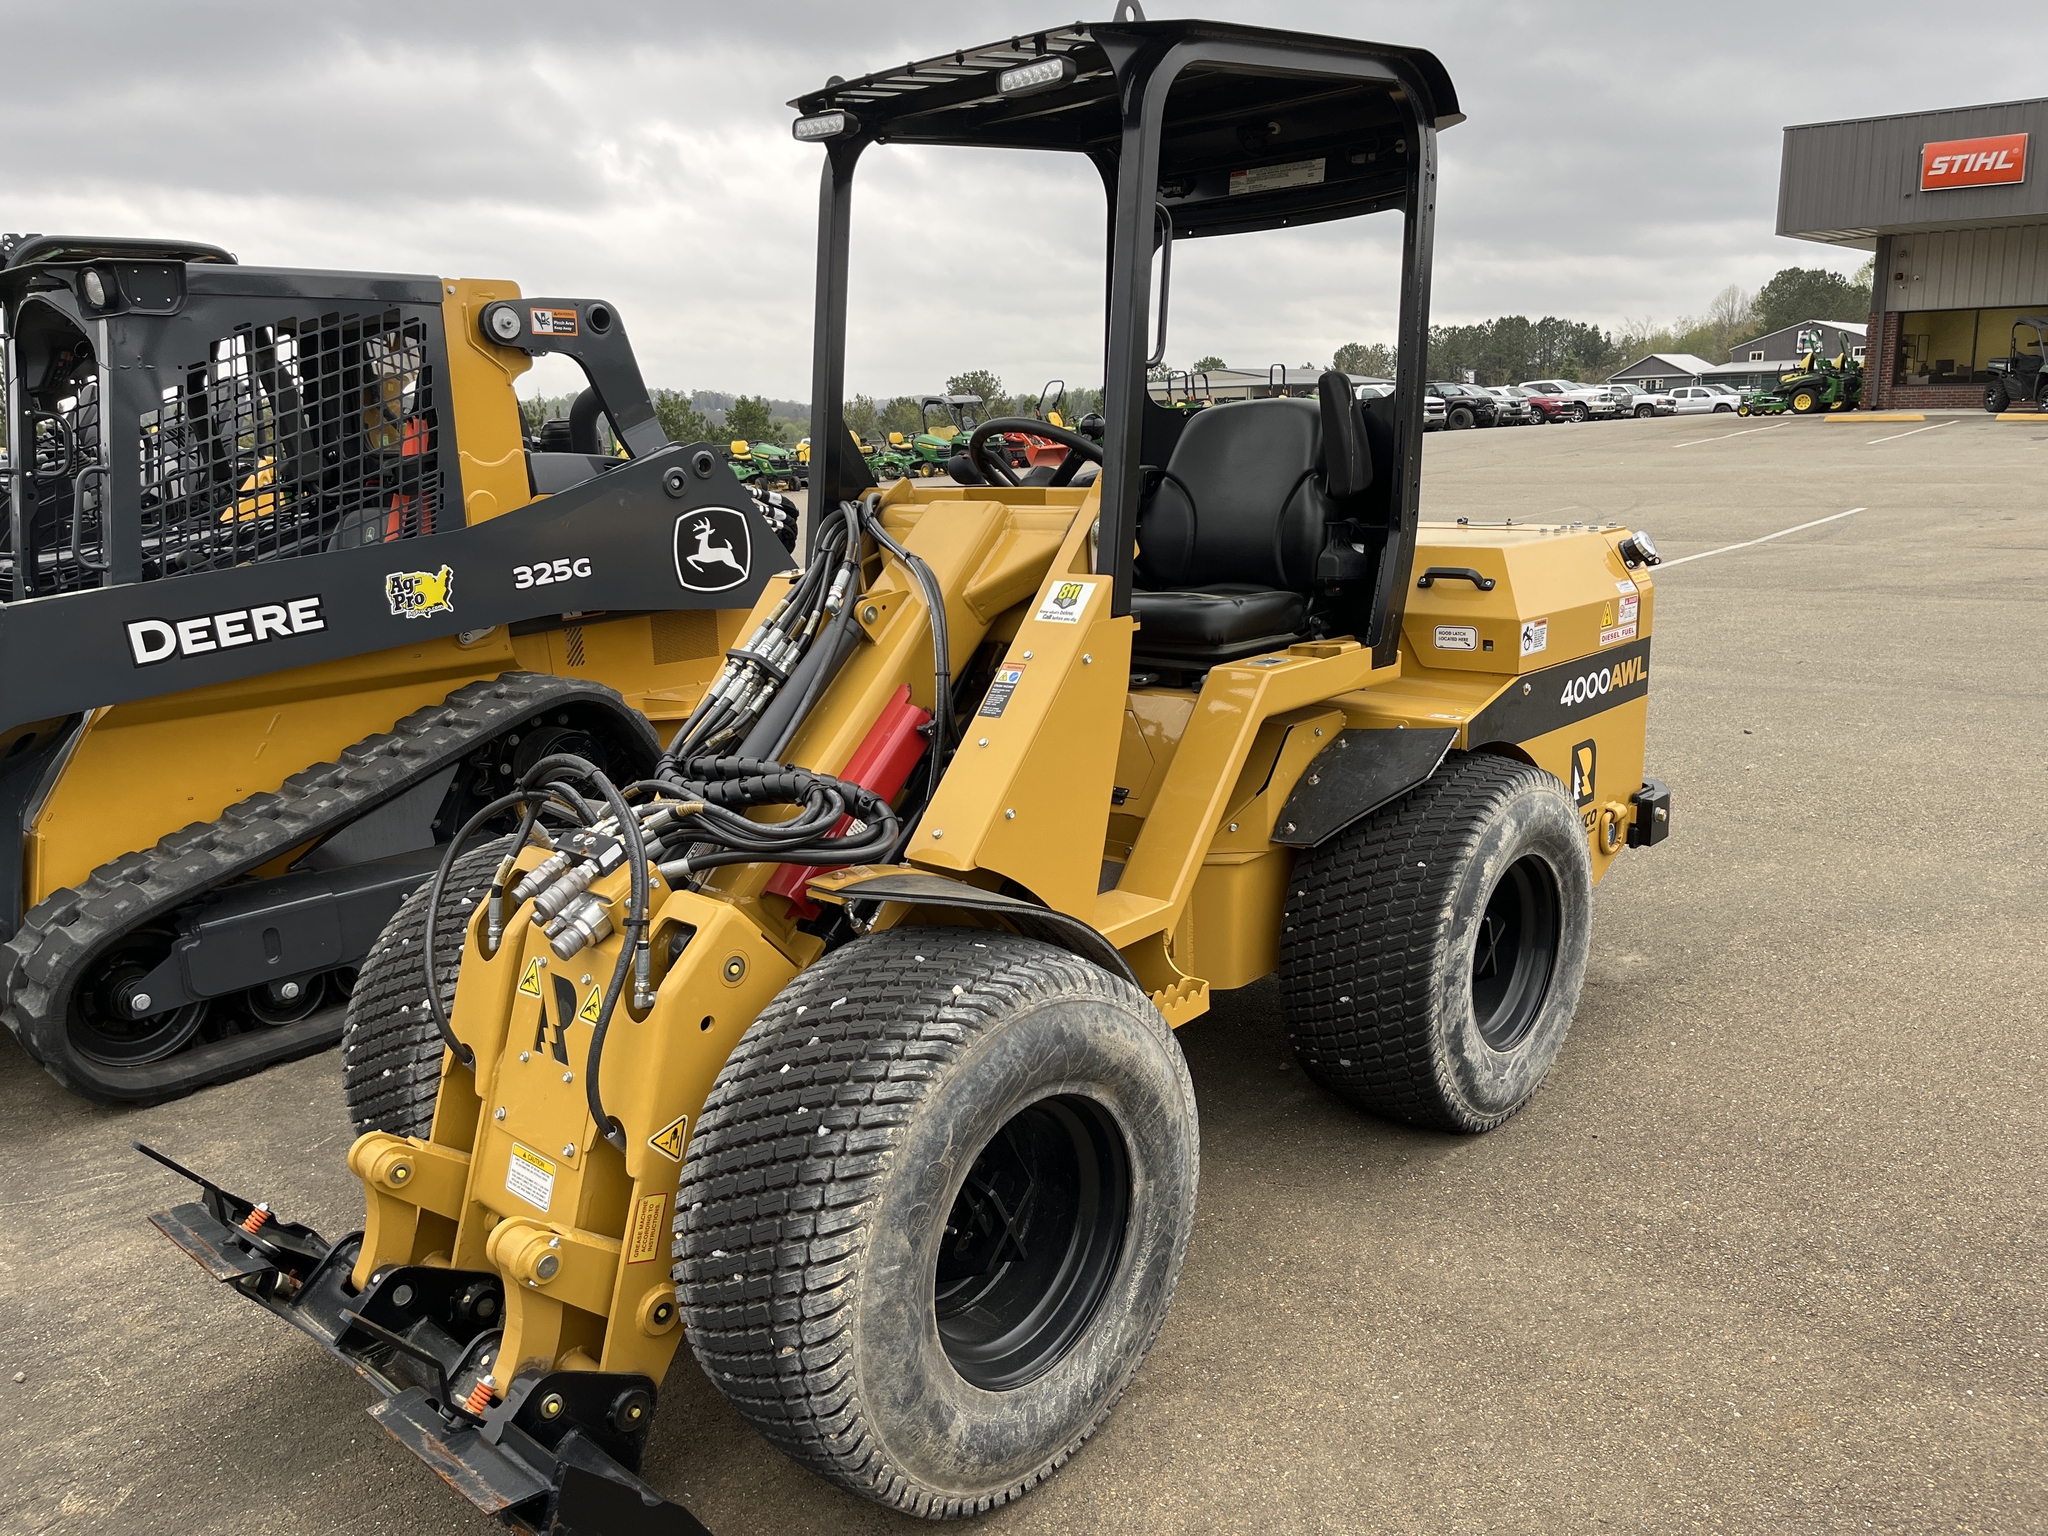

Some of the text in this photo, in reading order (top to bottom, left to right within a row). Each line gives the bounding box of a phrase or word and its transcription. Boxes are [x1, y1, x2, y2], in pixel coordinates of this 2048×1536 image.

[1927, 149, 2014, 176] STIHL
[390, 576, 422, 595] Ag-
[513, 558, 592, 589] 325G
[392, 592, 426, 611] Pro
[1058, 583, 1083, 600] 811
[127, 597, 325, 665] DEERE
[1602, 627, 1634, 642] DIESEL FUEL
[1560, 656, 1647, 707] 4000AWL
[528, 1154, 545, 1168] CAUTION
[634, 1200, 649, 1258] GREASE MACHINE
[641, 1203, 655, 1253] ACCORDING TO
